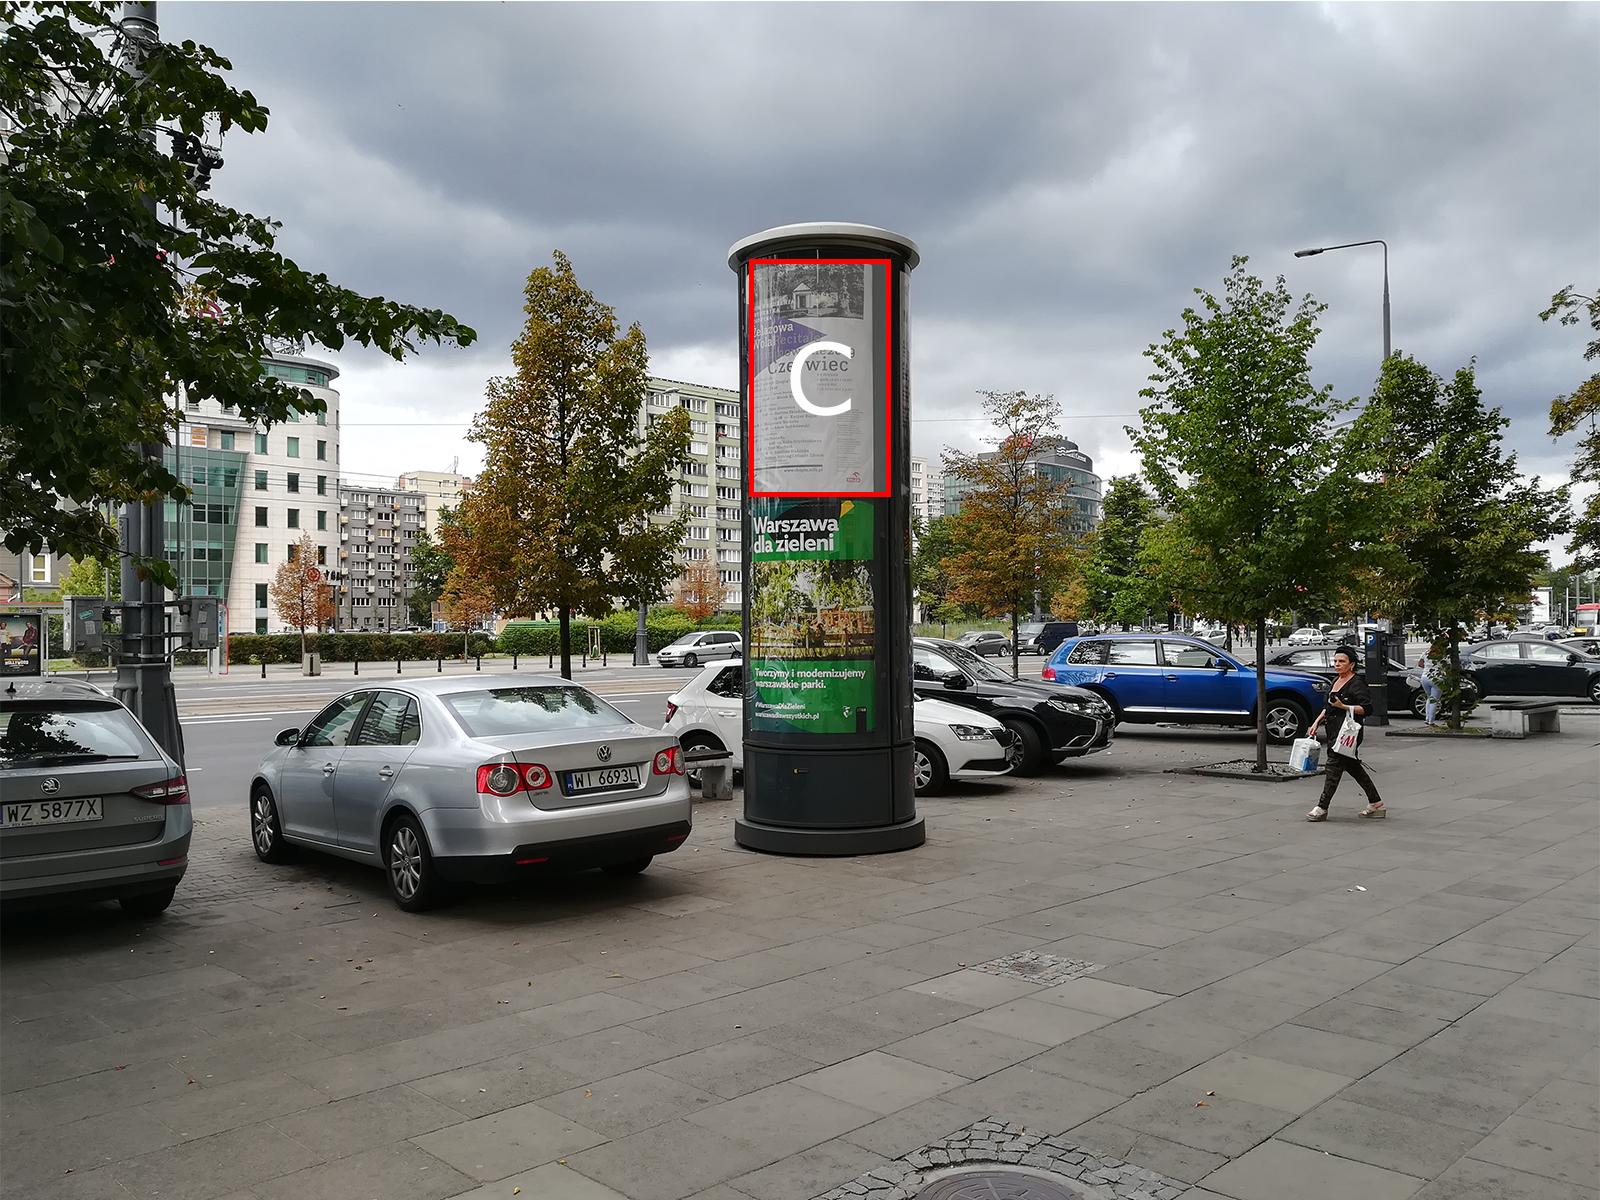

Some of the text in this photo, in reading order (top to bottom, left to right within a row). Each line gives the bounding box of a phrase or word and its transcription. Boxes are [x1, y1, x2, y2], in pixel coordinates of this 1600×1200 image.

[768, 356, 849, 374] Czewiec
[753, 516, 839, 534] Warszawa
[753, 533, 834, 553] dla zieleni
[755, 668, 866, 679] Tworzymy i modernizujemy
[801, 680, 826, 690] parki.
[599, 768, 637, 785] 6693L
[7, 799, 97, 822] WZ 5877X
